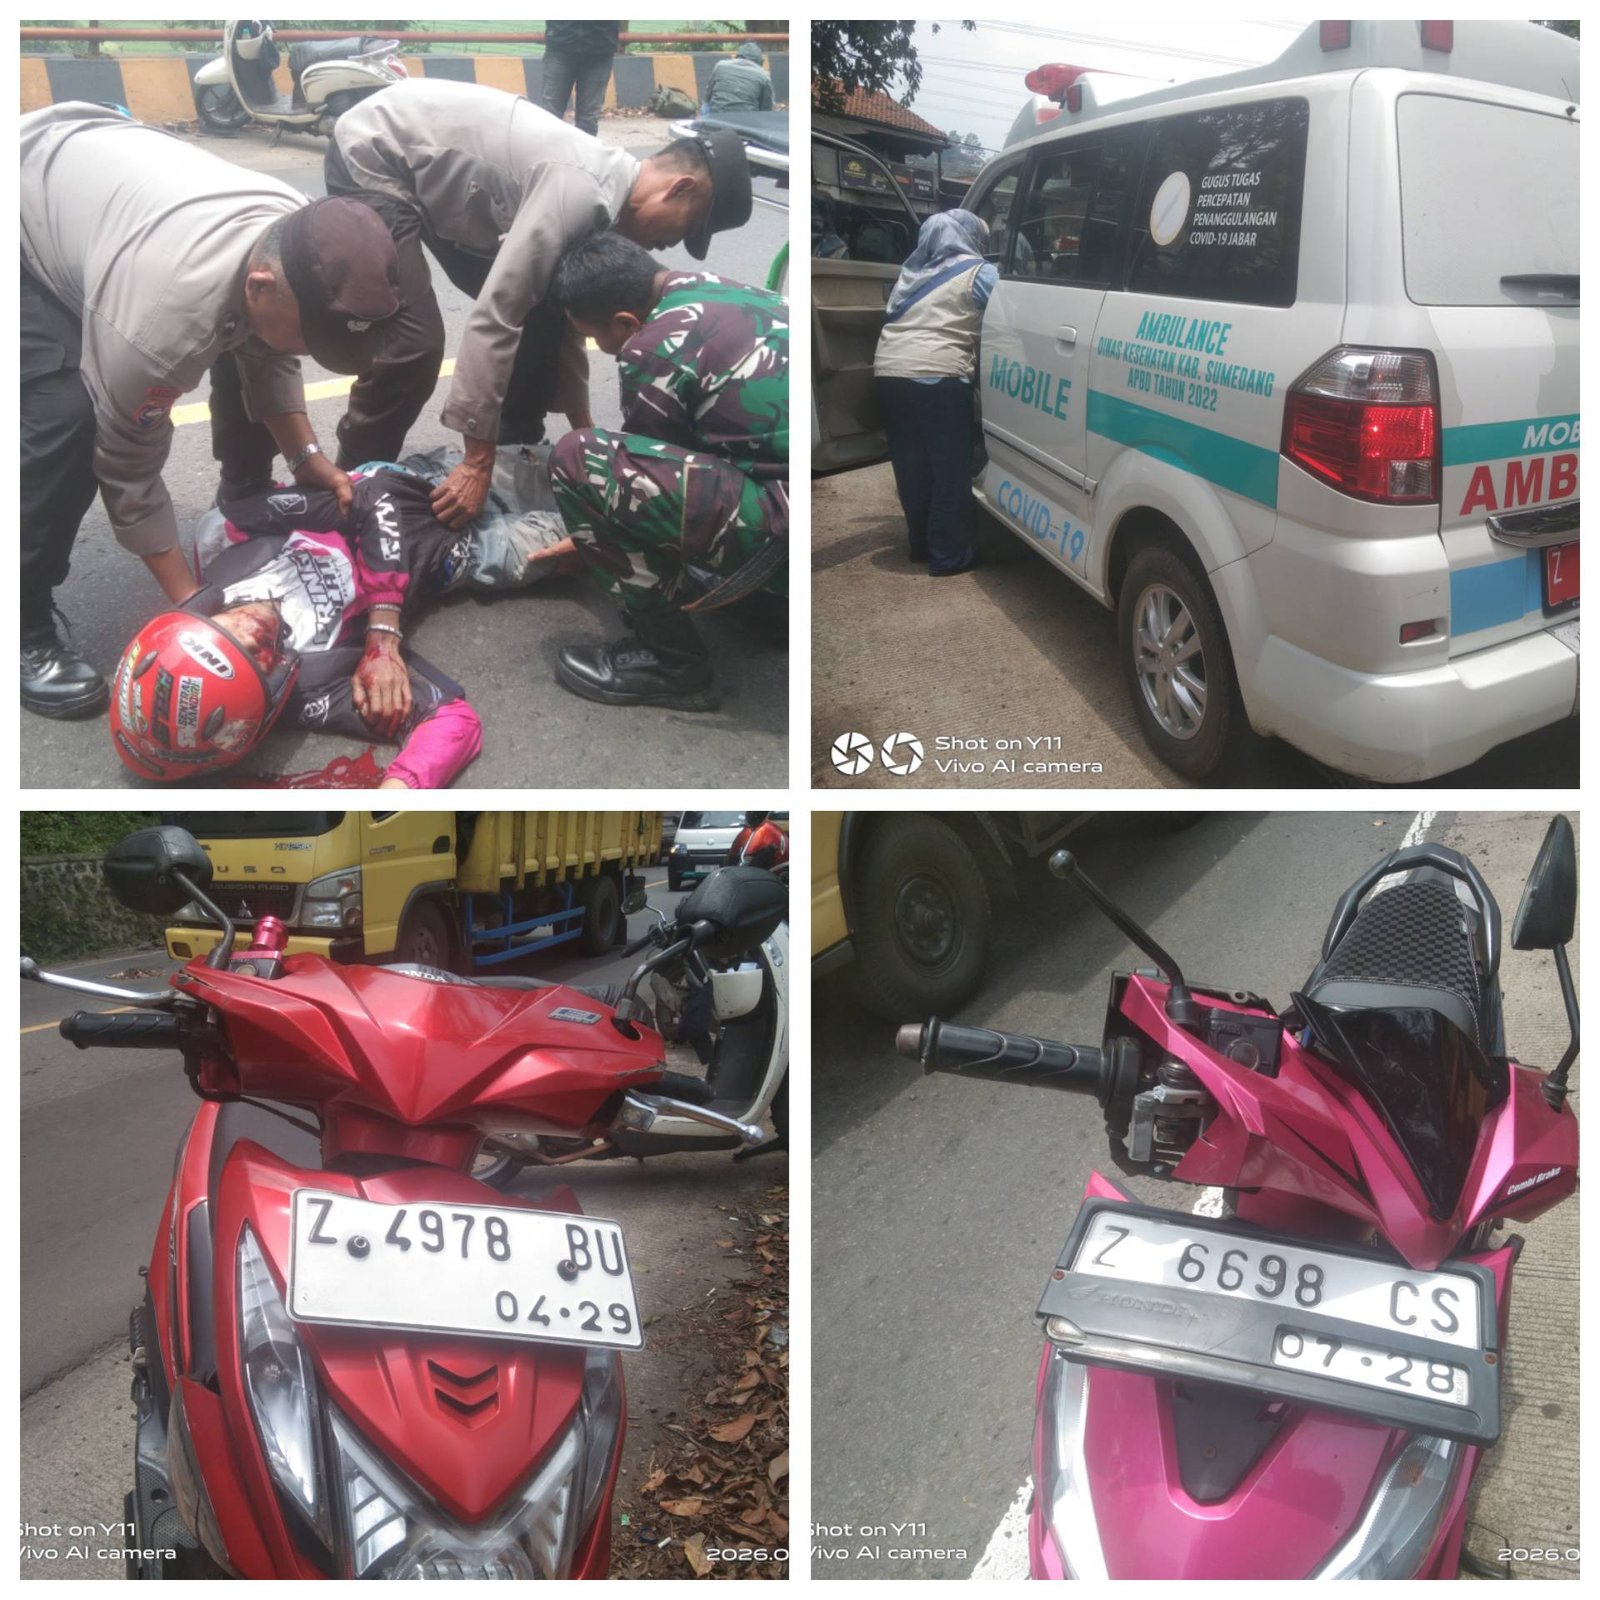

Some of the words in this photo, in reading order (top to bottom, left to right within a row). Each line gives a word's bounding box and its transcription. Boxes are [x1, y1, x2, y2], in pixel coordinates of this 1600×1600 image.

[1196, 192, 1252, 208] PERCEPATAN
[1201, 174, 1231, 189] GUGUS
[1232, 171, 1262, 187] TUGAS
[1189, 231, 1228, 246] COVID-19
[1227, 231, 1258, 247] JABAR
[1193, 211, 1278, 226] PENANGGULANGAN
[1135, 311, 1233, 357] AMBULANCE
[989, 353, 1073, 422] MOBILE
[1097, 336, 1123, 361] DINAS
[1122, 341, 1177, 375] KESEHATAN
[1176, 353, 1201, 381] KAB.
[1205, 360, 1276, 398] SUMEDANG
[1154, 374, 1186, 403] TAHUN
[1188, 383, 1219, 412] 2022
[1459, 453, 1579, 516] AMB
[997, 480, 1085, 562] COVID-19
[1551, 551, 1563, 585] Z
[307, 1198, 337, 1244] Z
[385, 1208, 512, 1262] 4978
[565, 1223, 625, 1277] BU
[1091, 1224, 1130, 1268] Z
[1177, 1242, 1325, 1308] 6698
[1389, 1280, 1460, 1334] CS
